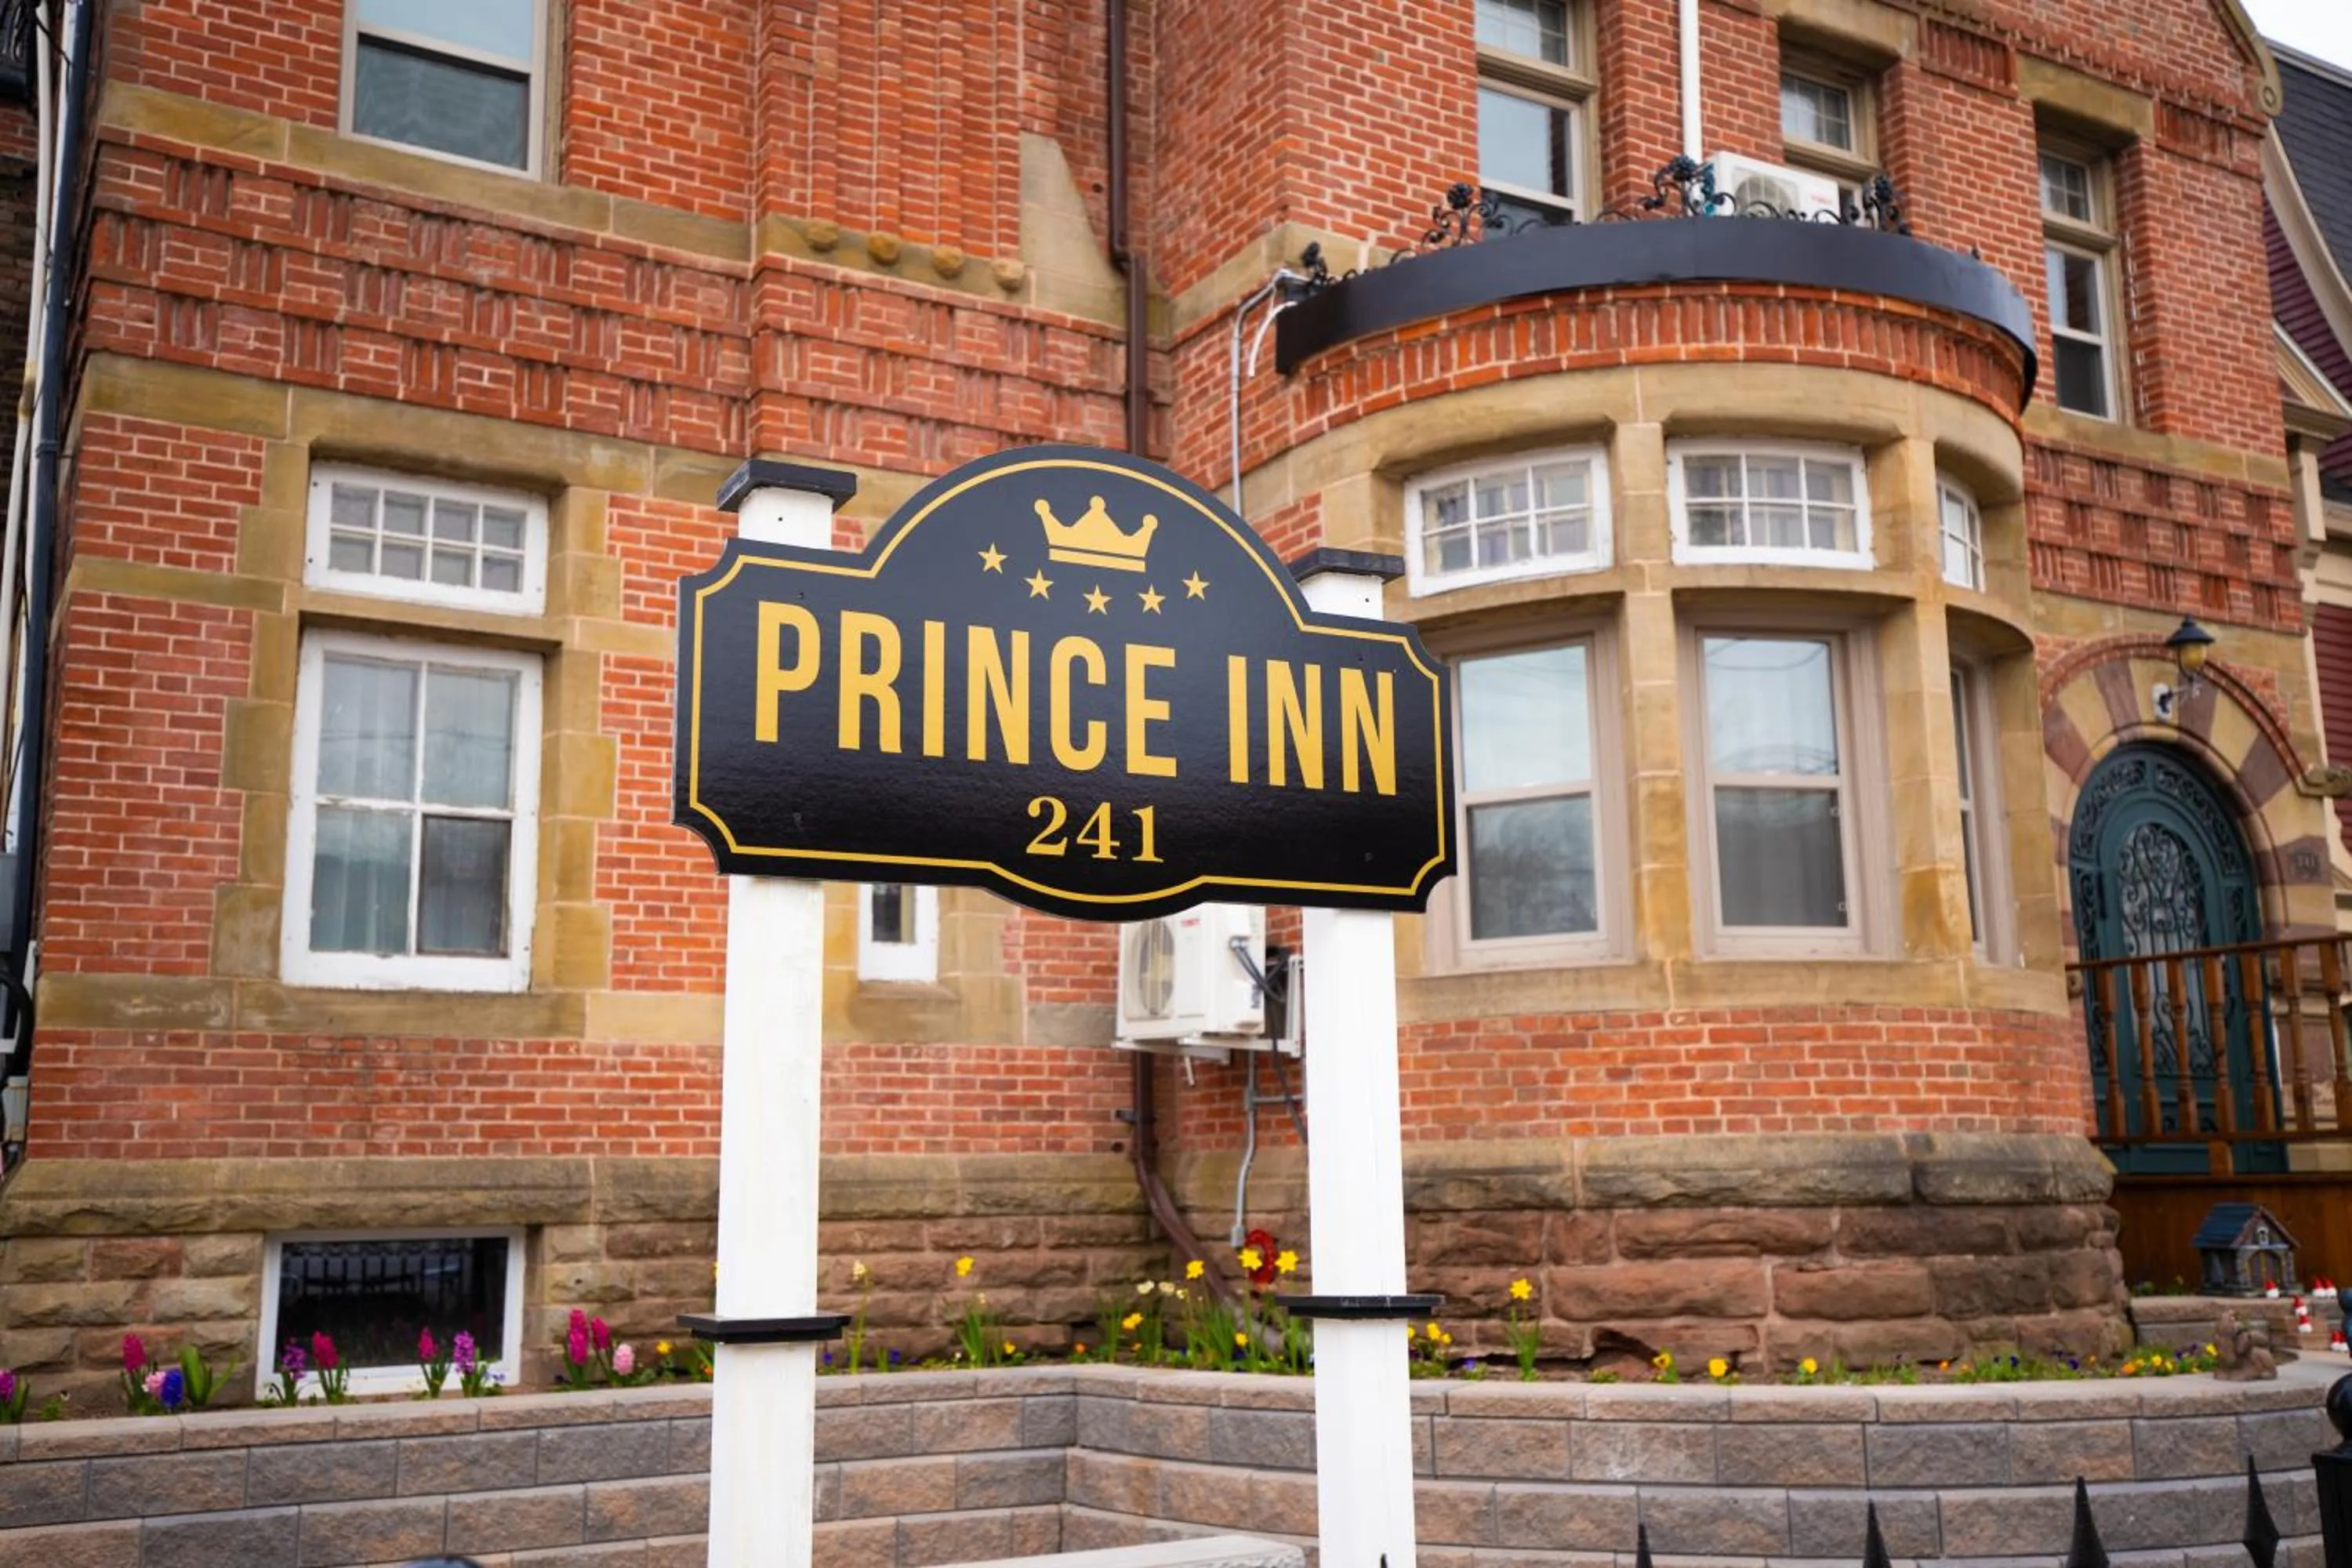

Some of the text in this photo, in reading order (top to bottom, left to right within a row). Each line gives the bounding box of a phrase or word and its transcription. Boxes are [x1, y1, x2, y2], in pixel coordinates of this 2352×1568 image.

[755, 600, 1396, 796] PRINCE INN
[1025, 796, 1164, 863] 241
